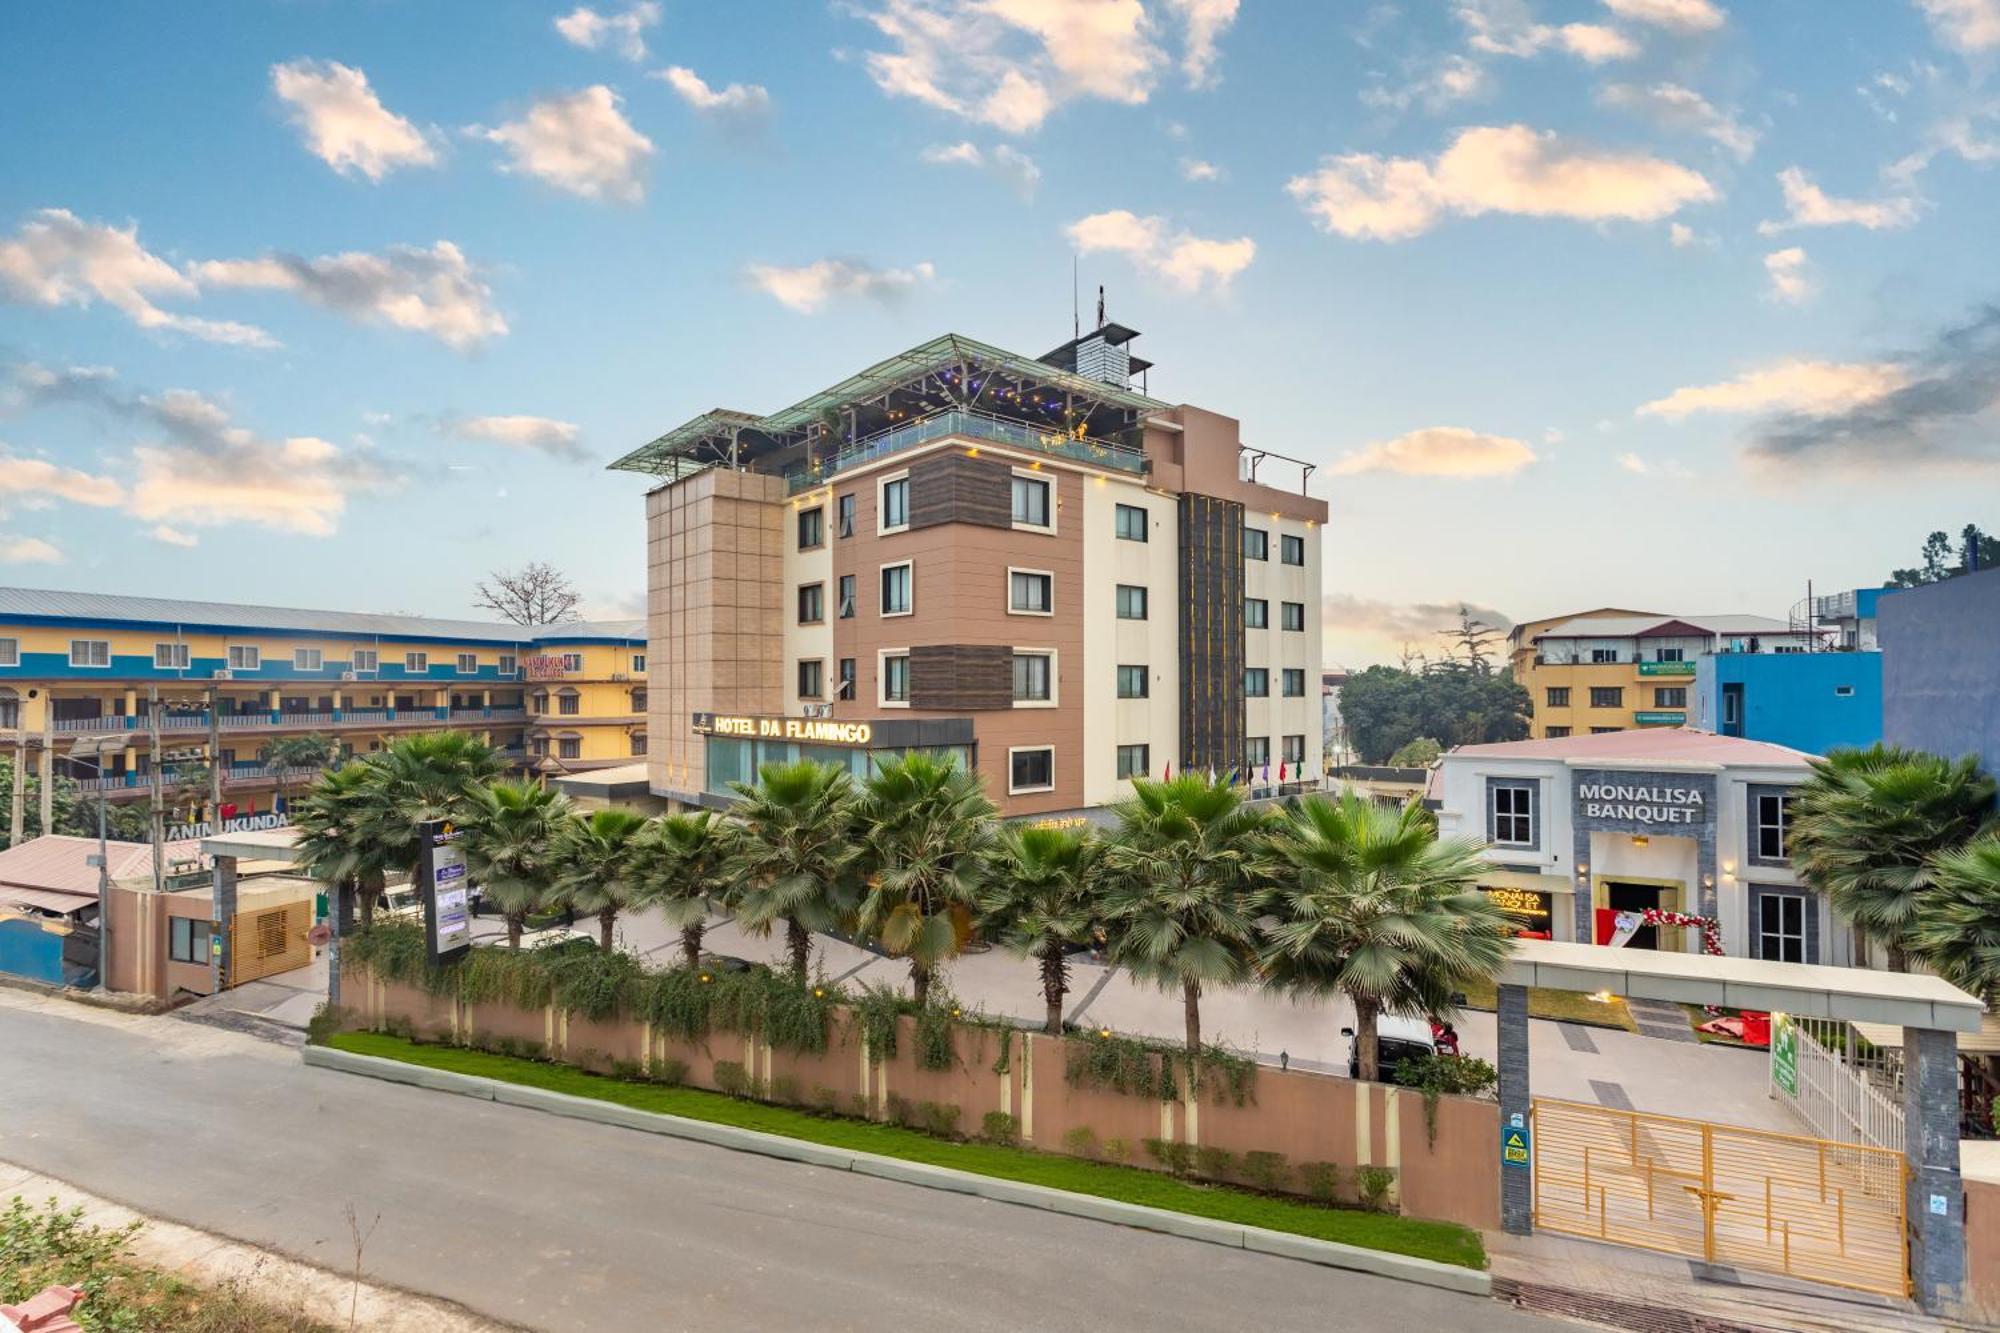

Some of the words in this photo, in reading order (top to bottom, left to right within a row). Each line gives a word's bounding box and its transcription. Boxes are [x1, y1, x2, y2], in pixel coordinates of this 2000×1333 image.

[715, 717, 756, 735] HOTEL
[761, 720, 781, 737] DA
[786, 721, 871, 743] FLAMINGO
[1579, 785, 1703, 804] MONALISA
[1587, 803, 1696, 824] BANQUET
